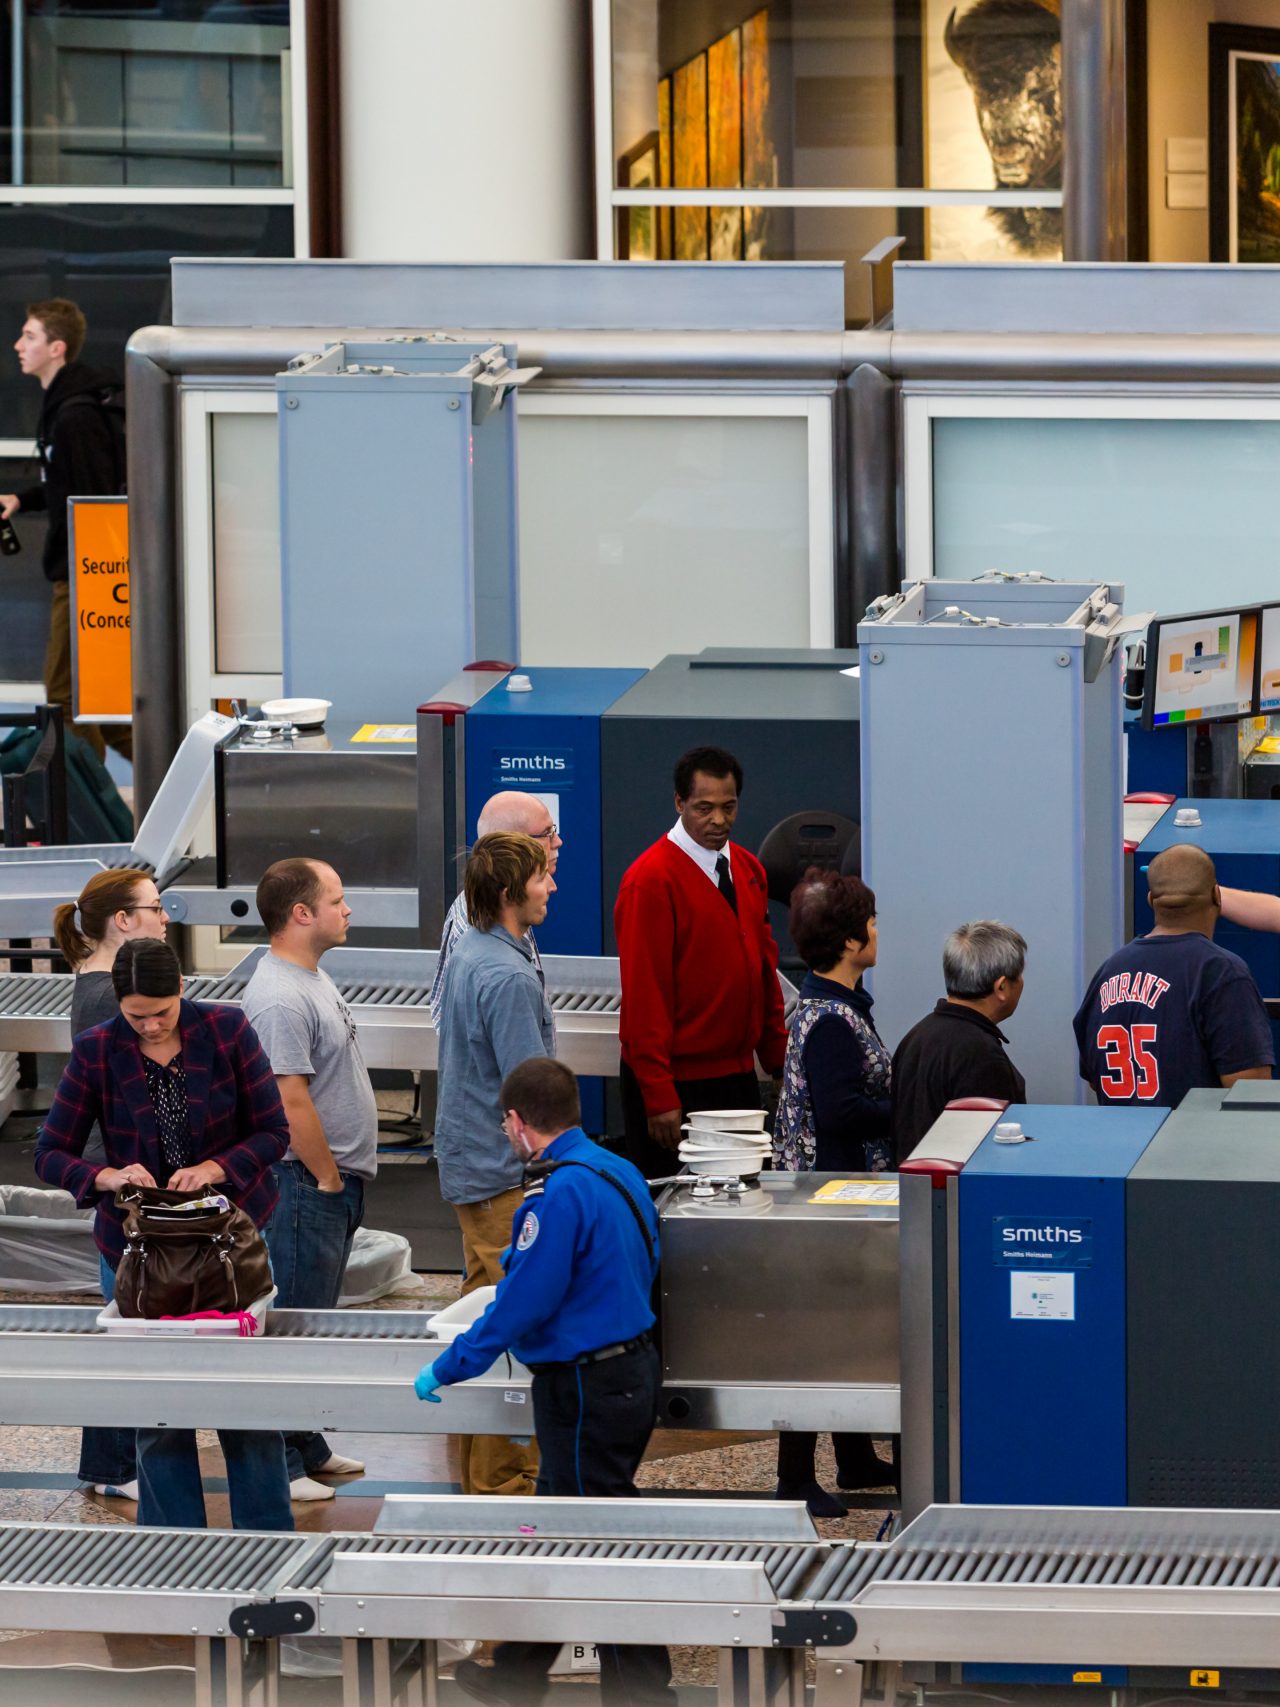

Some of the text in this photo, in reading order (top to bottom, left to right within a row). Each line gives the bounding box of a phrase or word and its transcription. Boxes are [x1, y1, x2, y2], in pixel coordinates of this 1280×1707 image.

[500, 755, 566, 770] smiths
[1100, 972, 1171, 1014] DURANT
[1097, 1023, 1160, 1099] 35
[1002, 1225, 1083, 1243] smiths
